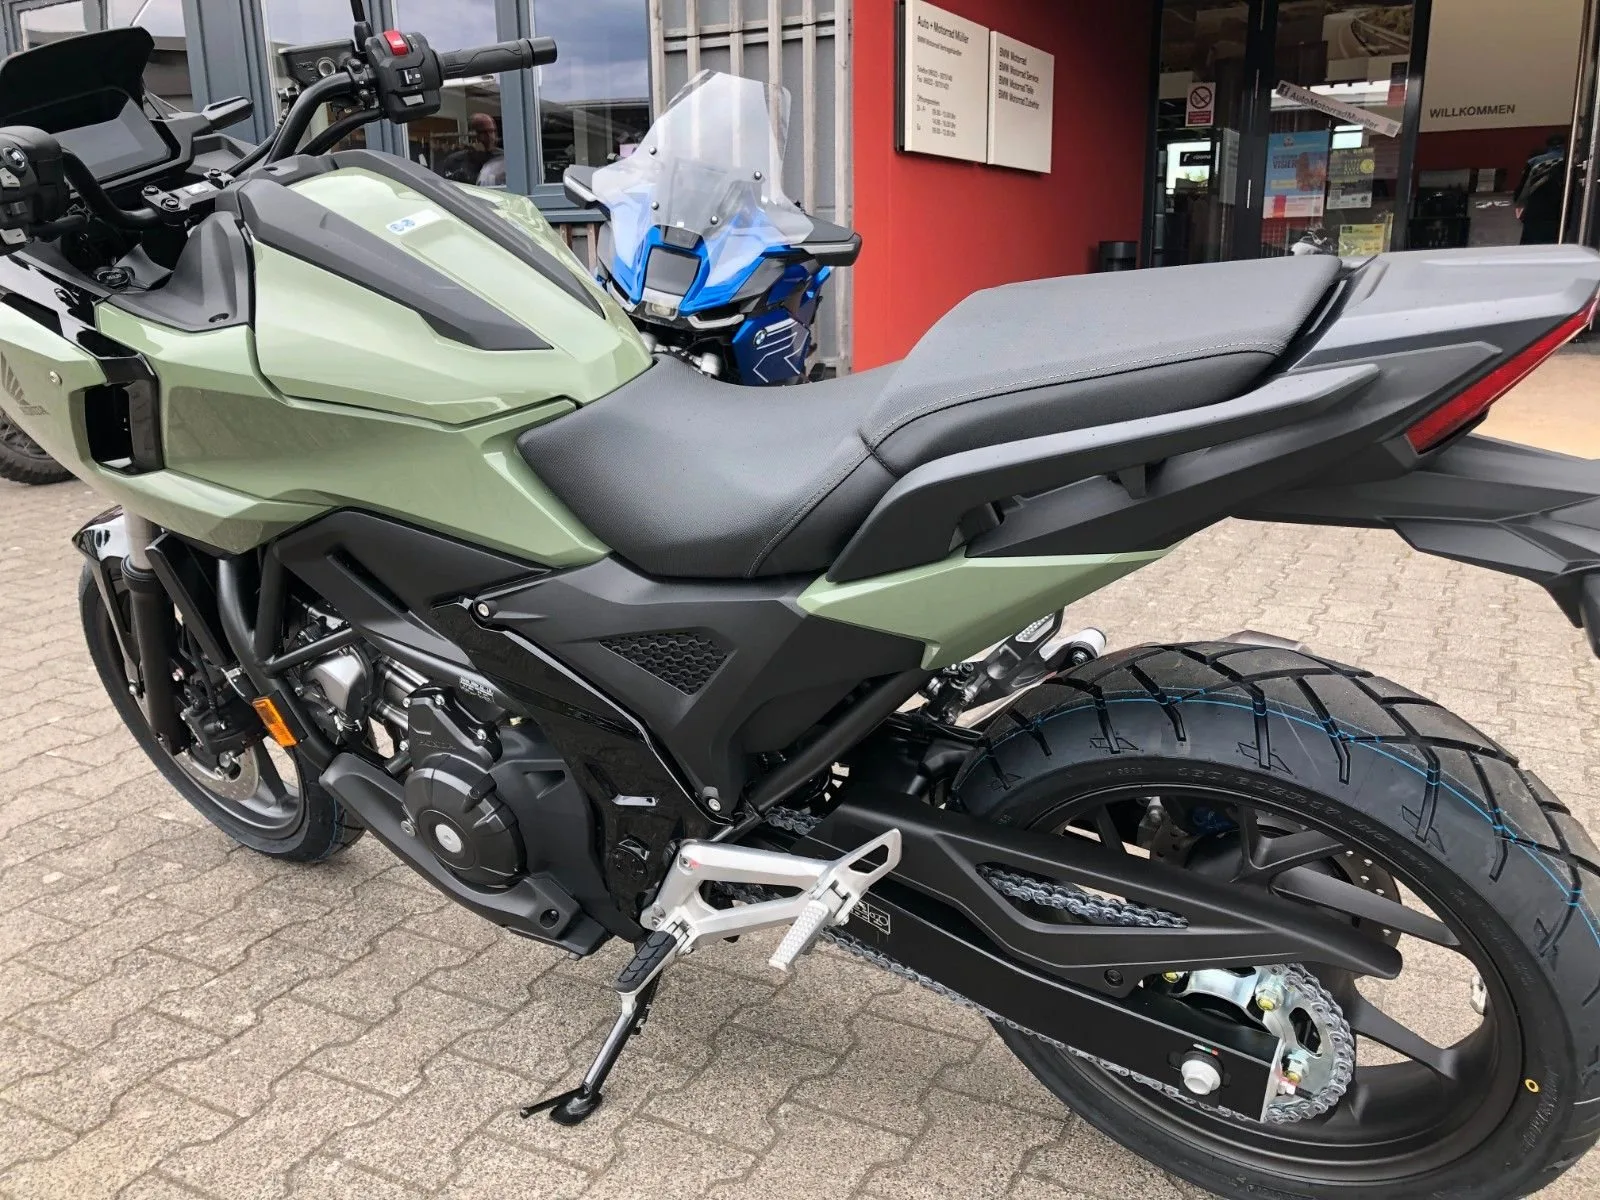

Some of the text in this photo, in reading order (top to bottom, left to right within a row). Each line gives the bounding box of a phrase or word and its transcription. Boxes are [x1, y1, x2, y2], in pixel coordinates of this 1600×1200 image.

[917, 15, 929, 30] Auto
[999, 47, 1027, 65] BMW Motorrad
[999, 61, 1009, 72] BMW
[1010, 65, 1026, 79] Motorrad
[998, 75, 1009, 86] BMW
[1009, 79, 1025, 92] Motorrad
[998, 89, 1009, 100] BMW
[1009, 93, 1025, 105] Motorrad
[1429, 104, 1516, 118] WILLKOMMEN
